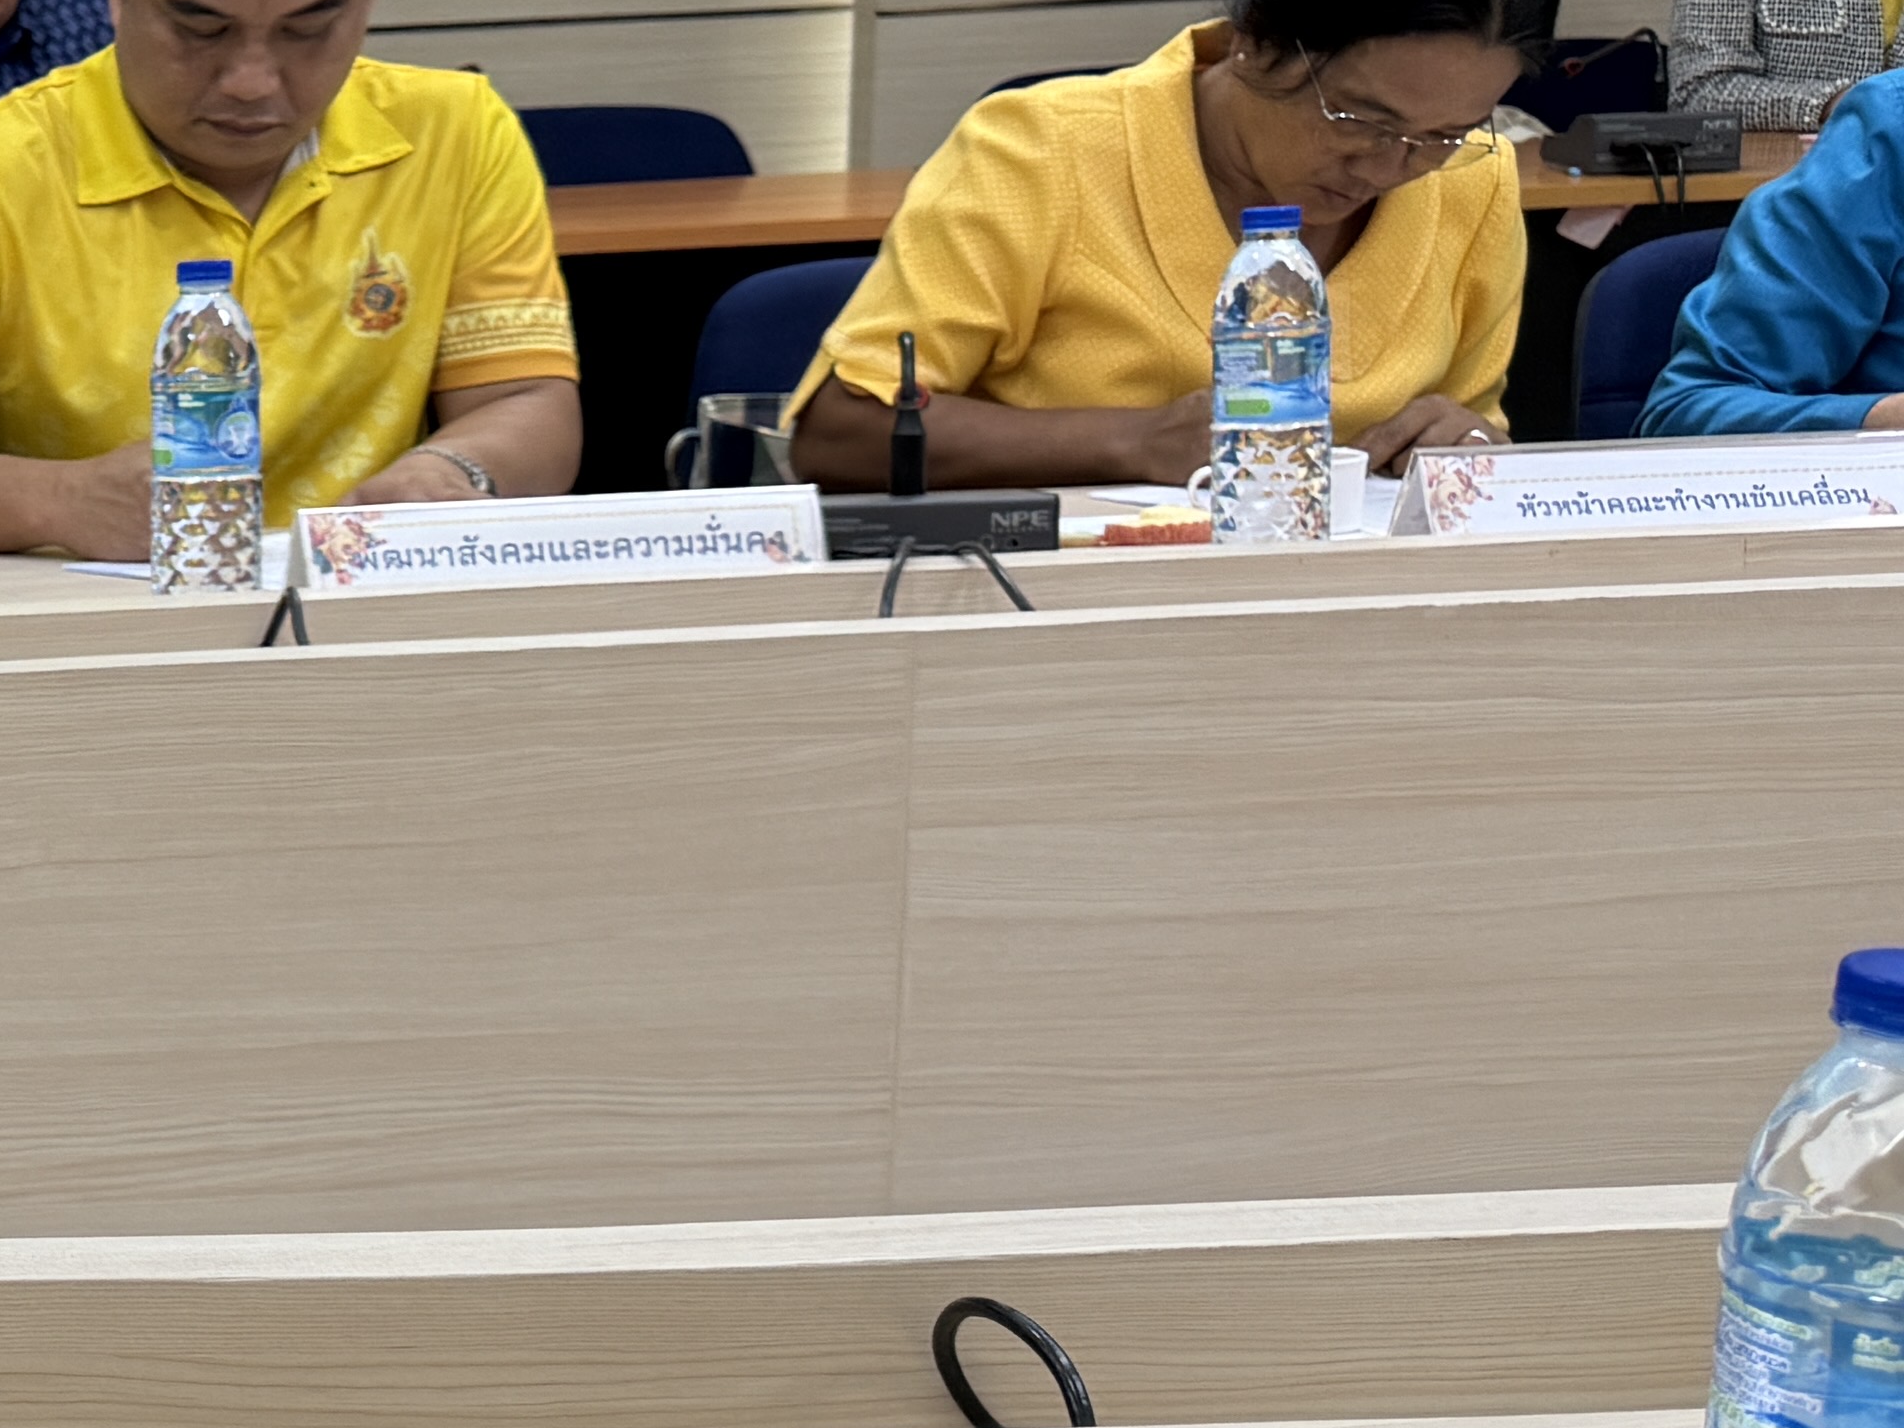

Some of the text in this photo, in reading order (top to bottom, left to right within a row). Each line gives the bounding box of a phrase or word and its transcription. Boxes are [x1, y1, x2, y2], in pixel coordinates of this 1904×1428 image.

[990, 509, 1050, 527] NPE
[1516, 475, 1871, 518] หัวหน้าคณะทำงานขับเคลื่อน
[356, 515, 786, 571] พัฒนาสังคมและความมั่นคง
